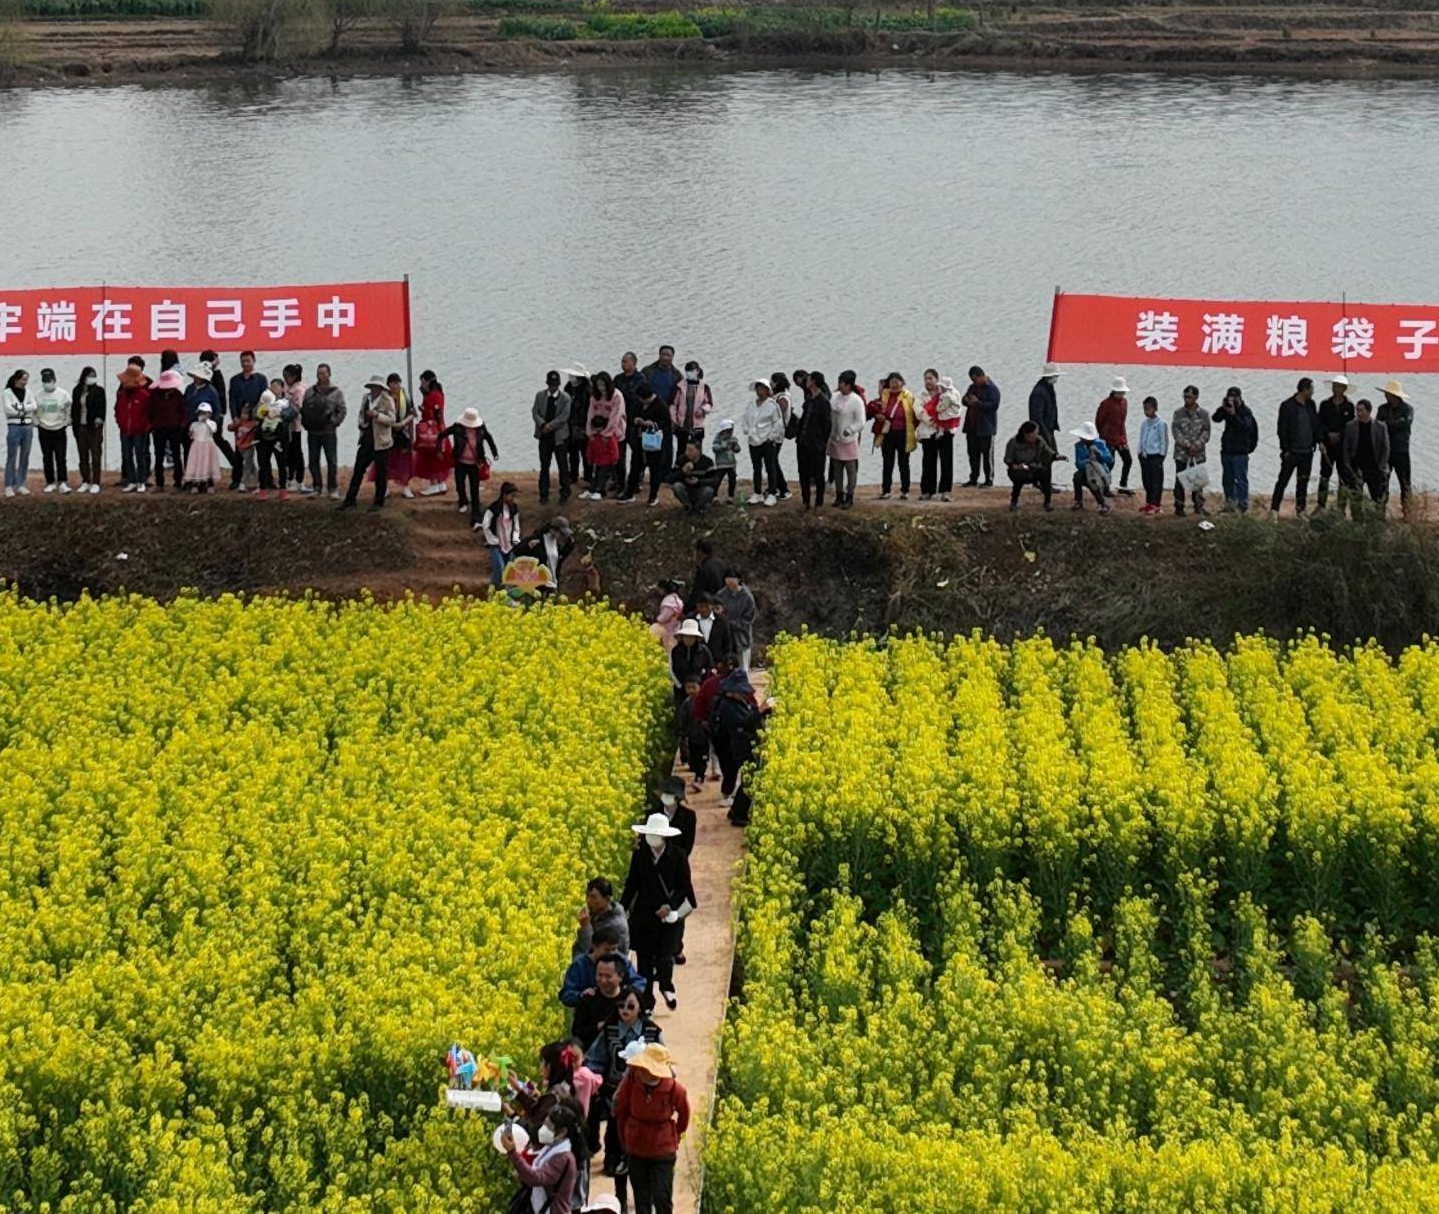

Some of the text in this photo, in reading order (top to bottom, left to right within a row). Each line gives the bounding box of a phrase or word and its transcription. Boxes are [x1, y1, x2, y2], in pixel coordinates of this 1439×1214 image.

[1134, 310, 1439, 359] 装满粮袋子
